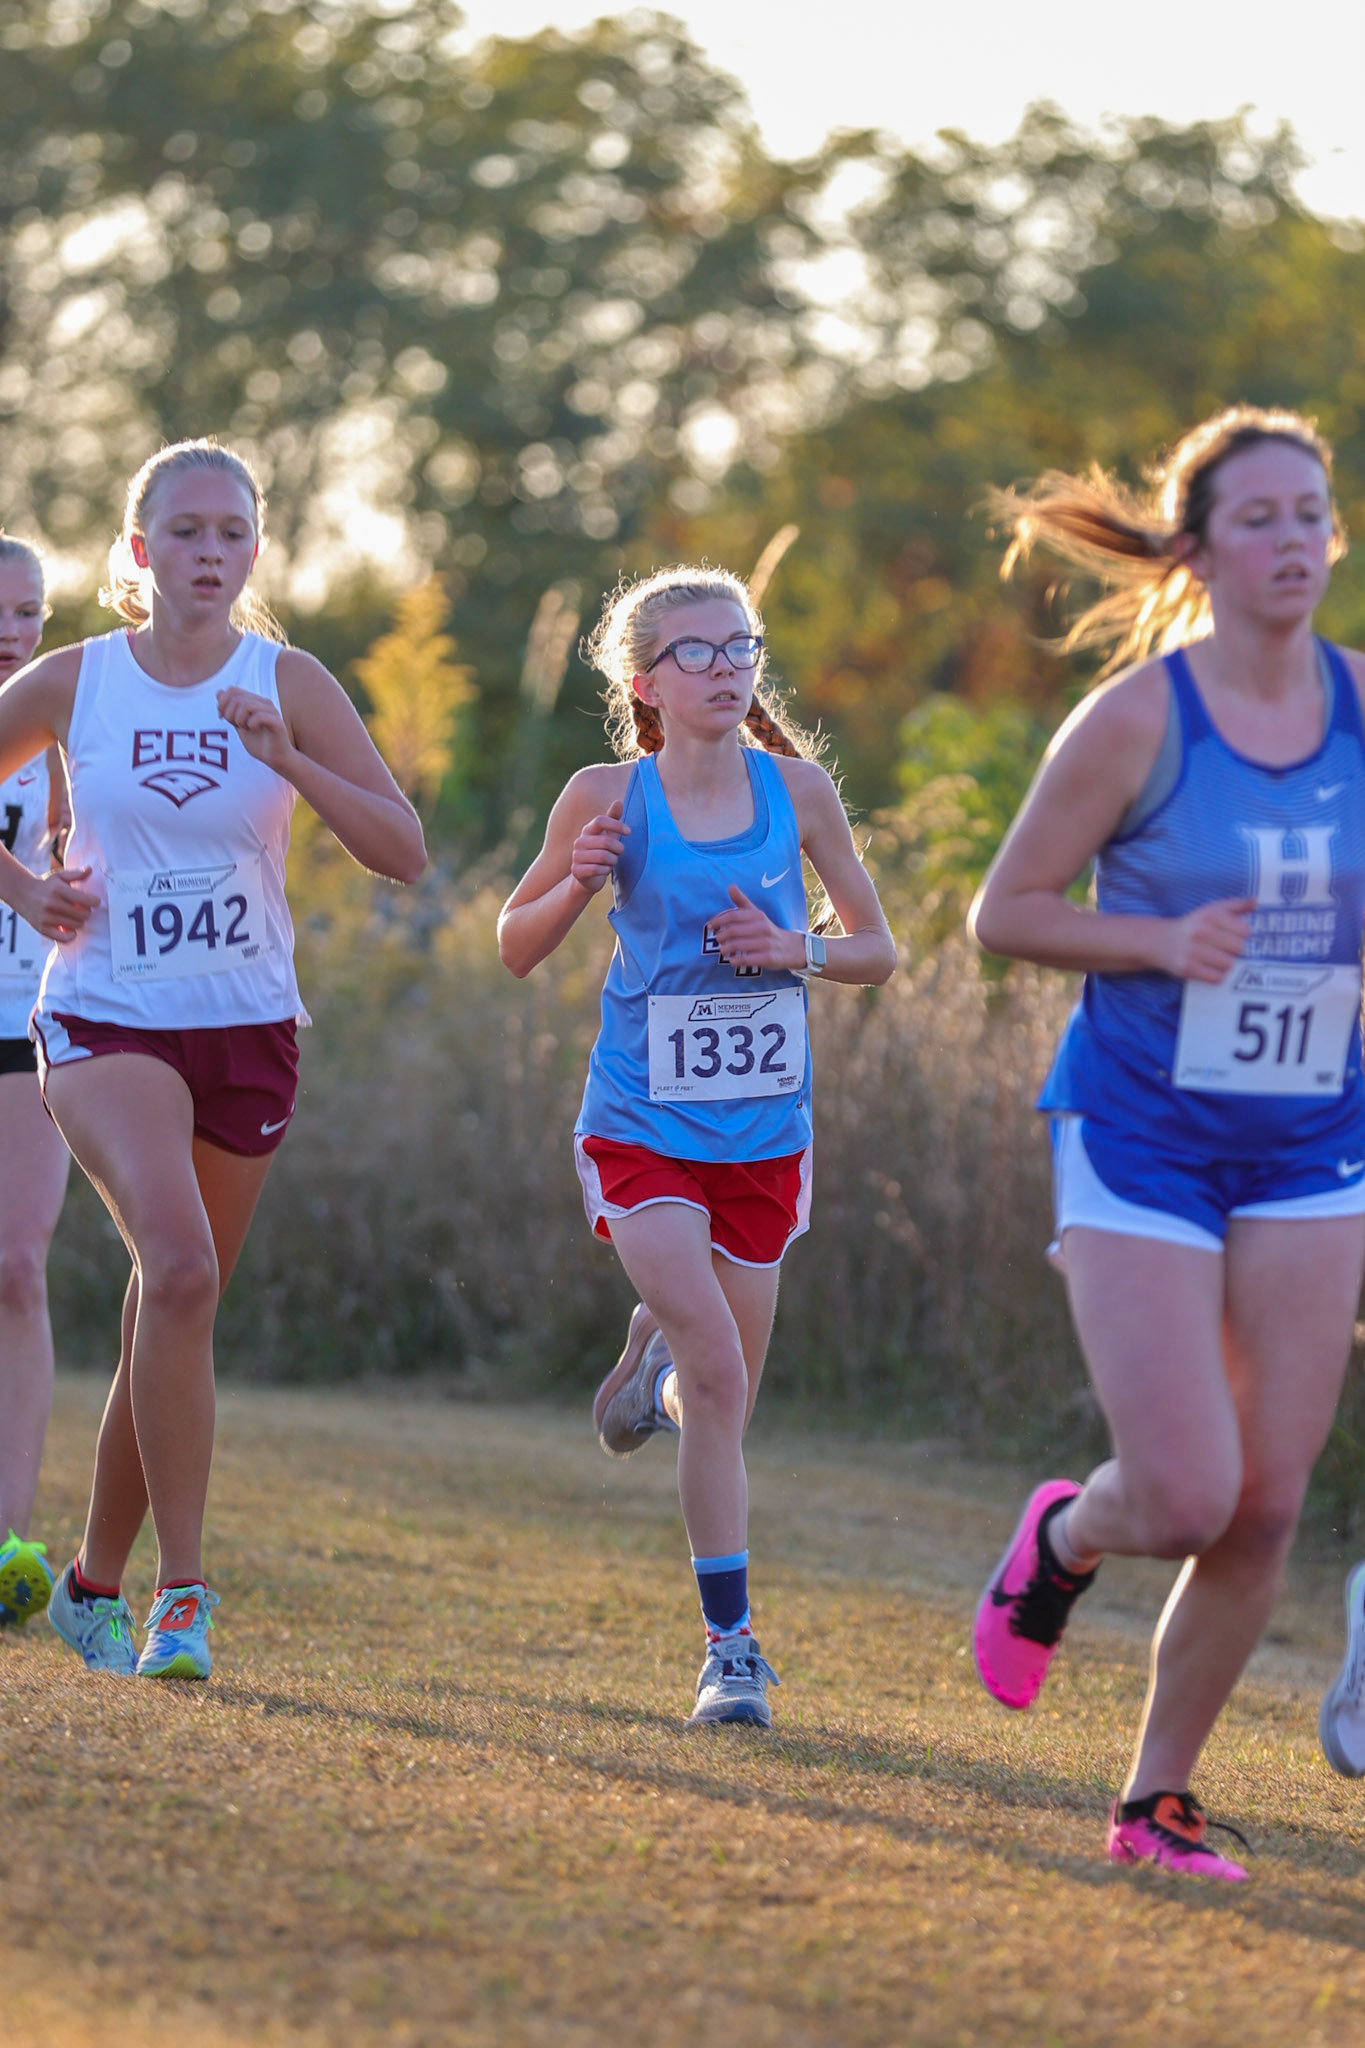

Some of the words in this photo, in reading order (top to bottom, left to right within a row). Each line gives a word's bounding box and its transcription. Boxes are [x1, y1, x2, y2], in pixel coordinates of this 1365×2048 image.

[132, 730, 229, 772] ECS
[1239, 824, 1339, 906] H
[127, 894, 250, 957] 1942
[696, 1004, 713, 1016] M
[1233, 1001, 1315, 1065] 511
[667, 1022, 788, 1079] 1332
